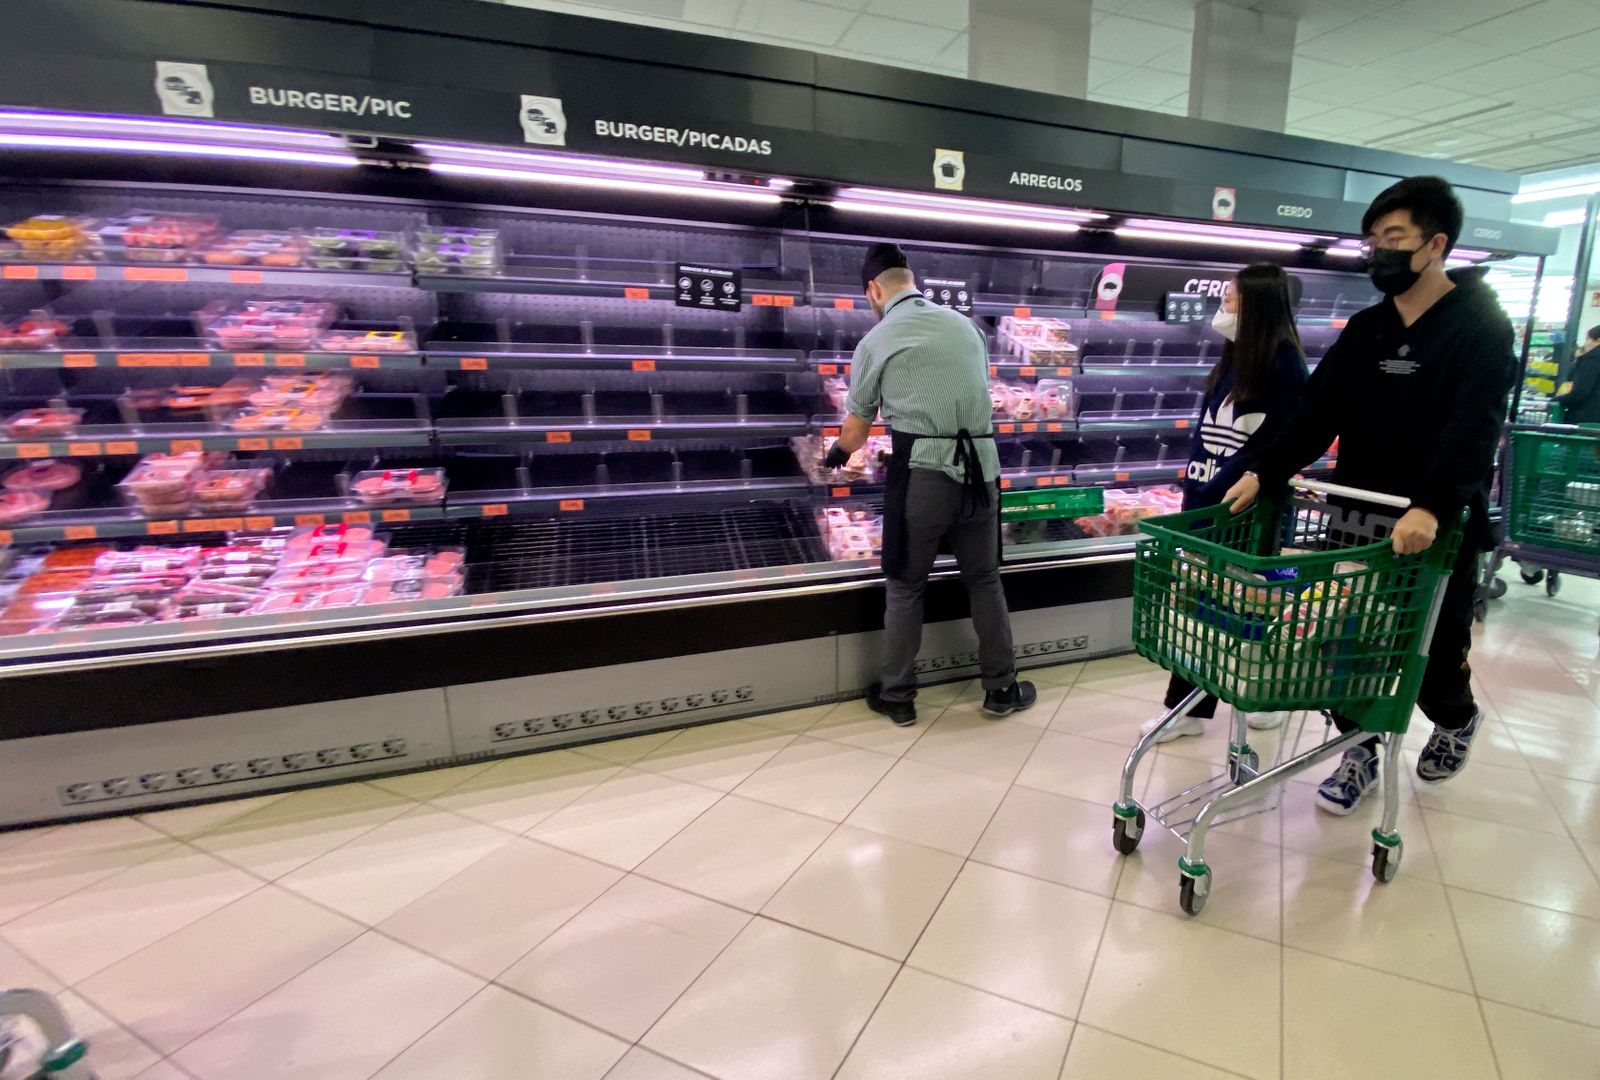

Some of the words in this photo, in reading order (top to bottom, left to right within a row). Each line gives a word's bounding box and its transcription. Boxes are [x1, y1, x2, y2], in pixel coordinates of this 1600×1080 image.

[249, 86, 412, 119] BURGER/PIC
[594, 119, 772, 156] BURGER/PICADAS
[1009, 171, 1083, 192] ARREGLOS
[1277, 204, 1313, 219] CERDO
